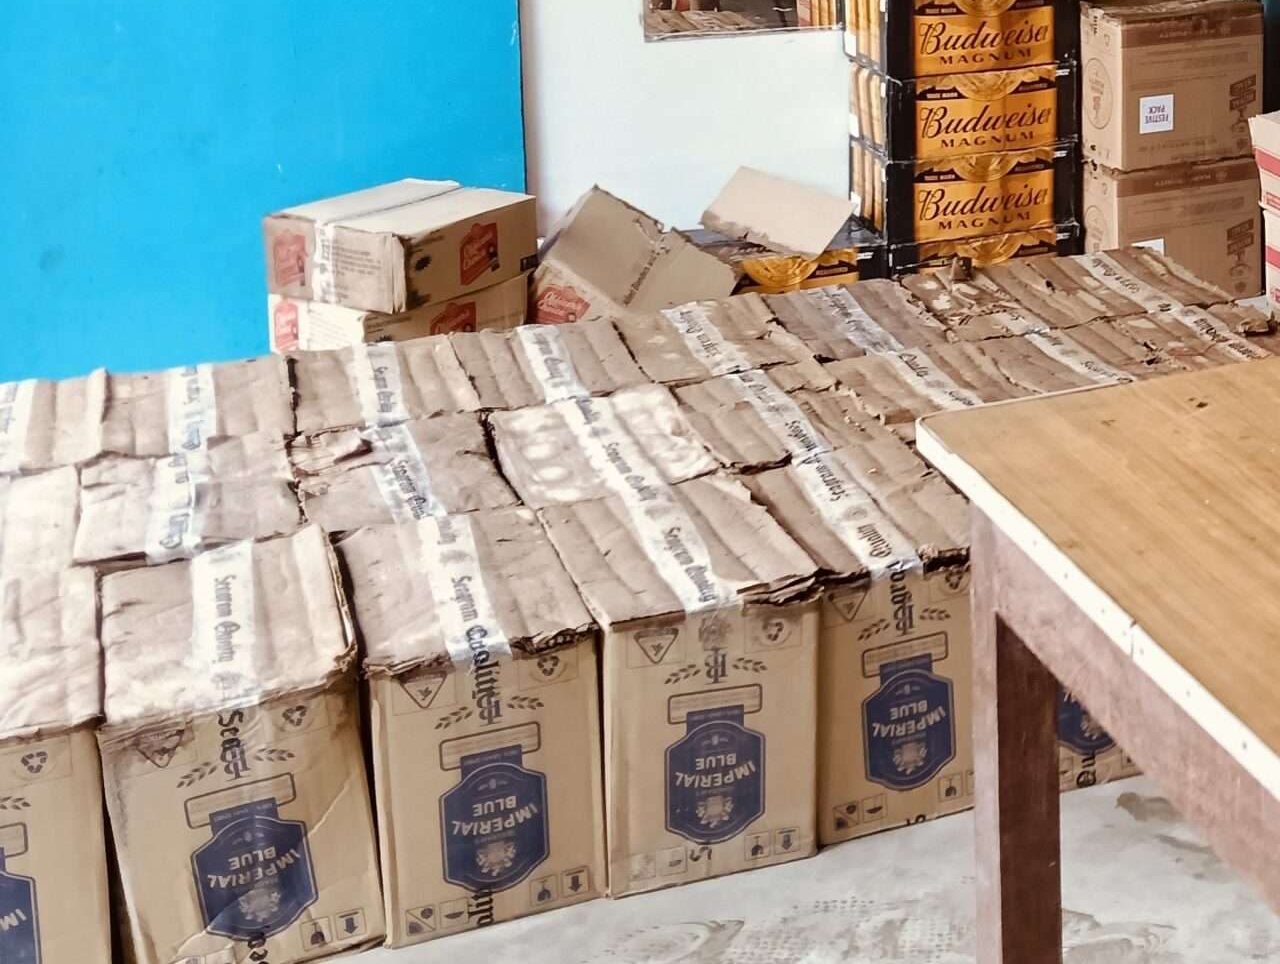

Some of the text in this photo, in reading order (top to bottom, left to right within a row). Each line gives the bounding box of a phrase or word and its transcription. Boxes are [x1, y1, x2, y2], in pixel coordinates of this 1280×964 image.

[919, 20, 1049, 55] Budweiser
[939, 48, 1032, 65] MAGNUM
[919, 103, 1051, 139] Budweiser
[940, 131, 1034, 149] MAGNUM
[919, 184, 1049, 221] Budweiser
[938, 212, 1031, 230] MAGNUM
[872, 705, 946, 738] IMPERIAL
[889, 699, 928, 720] BLUE
[674, 760, 756, 788] IMPERIAL
[695, 753, 737, 771] BLUE
[472, 795, 518, 817] BLUE
[452, 802, 538, 837] IMPERIAL
[207, 848, 301, 889] IMPERIAL
[228, 846, 277, 871] BLUE
